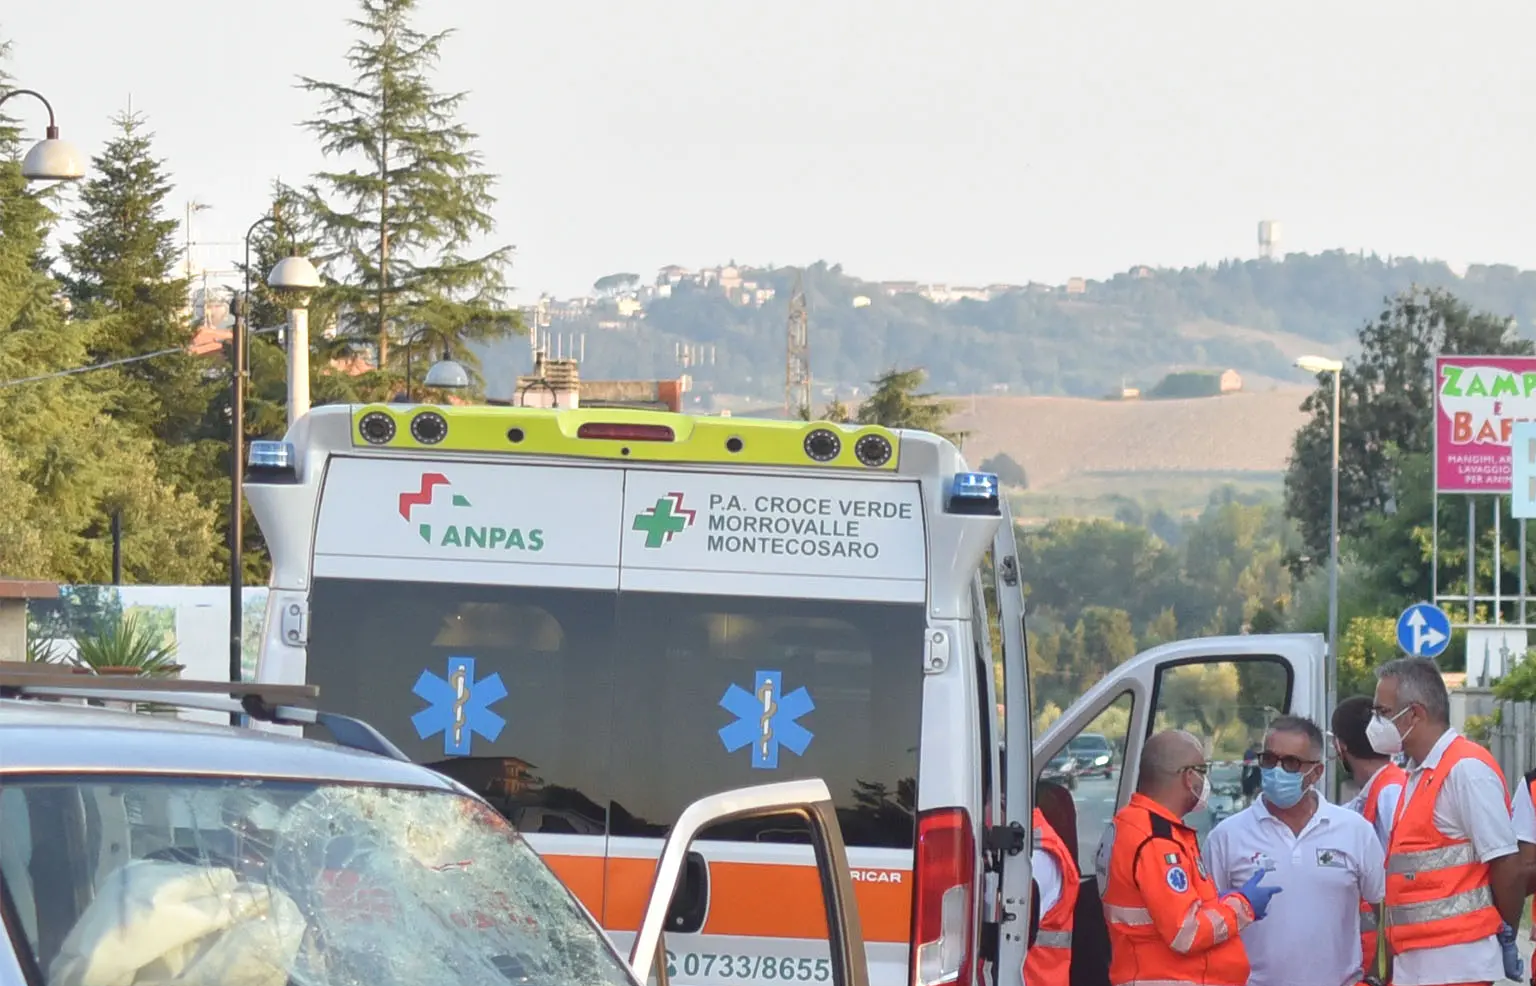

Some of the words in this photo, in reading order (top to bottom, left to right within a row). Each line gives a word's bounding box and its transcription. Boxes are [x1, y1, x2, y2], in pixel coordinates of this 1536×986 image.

[1458, 465, 1511, 474] LAVAGGIO
[709, 494, 747, 511] P.A.
[754, 496, 831, 516] CROCE
[839, 500, 913, 519] VERDE
[440, 525, 545, 551] ANPAS
[708, 515, 860, 537] MORROVALLE
[707, 535, 879, 559] MONTECOSARO
[849, 870, 902, 883] RICAR
[683, 953, 834, 982] 0733/8655
